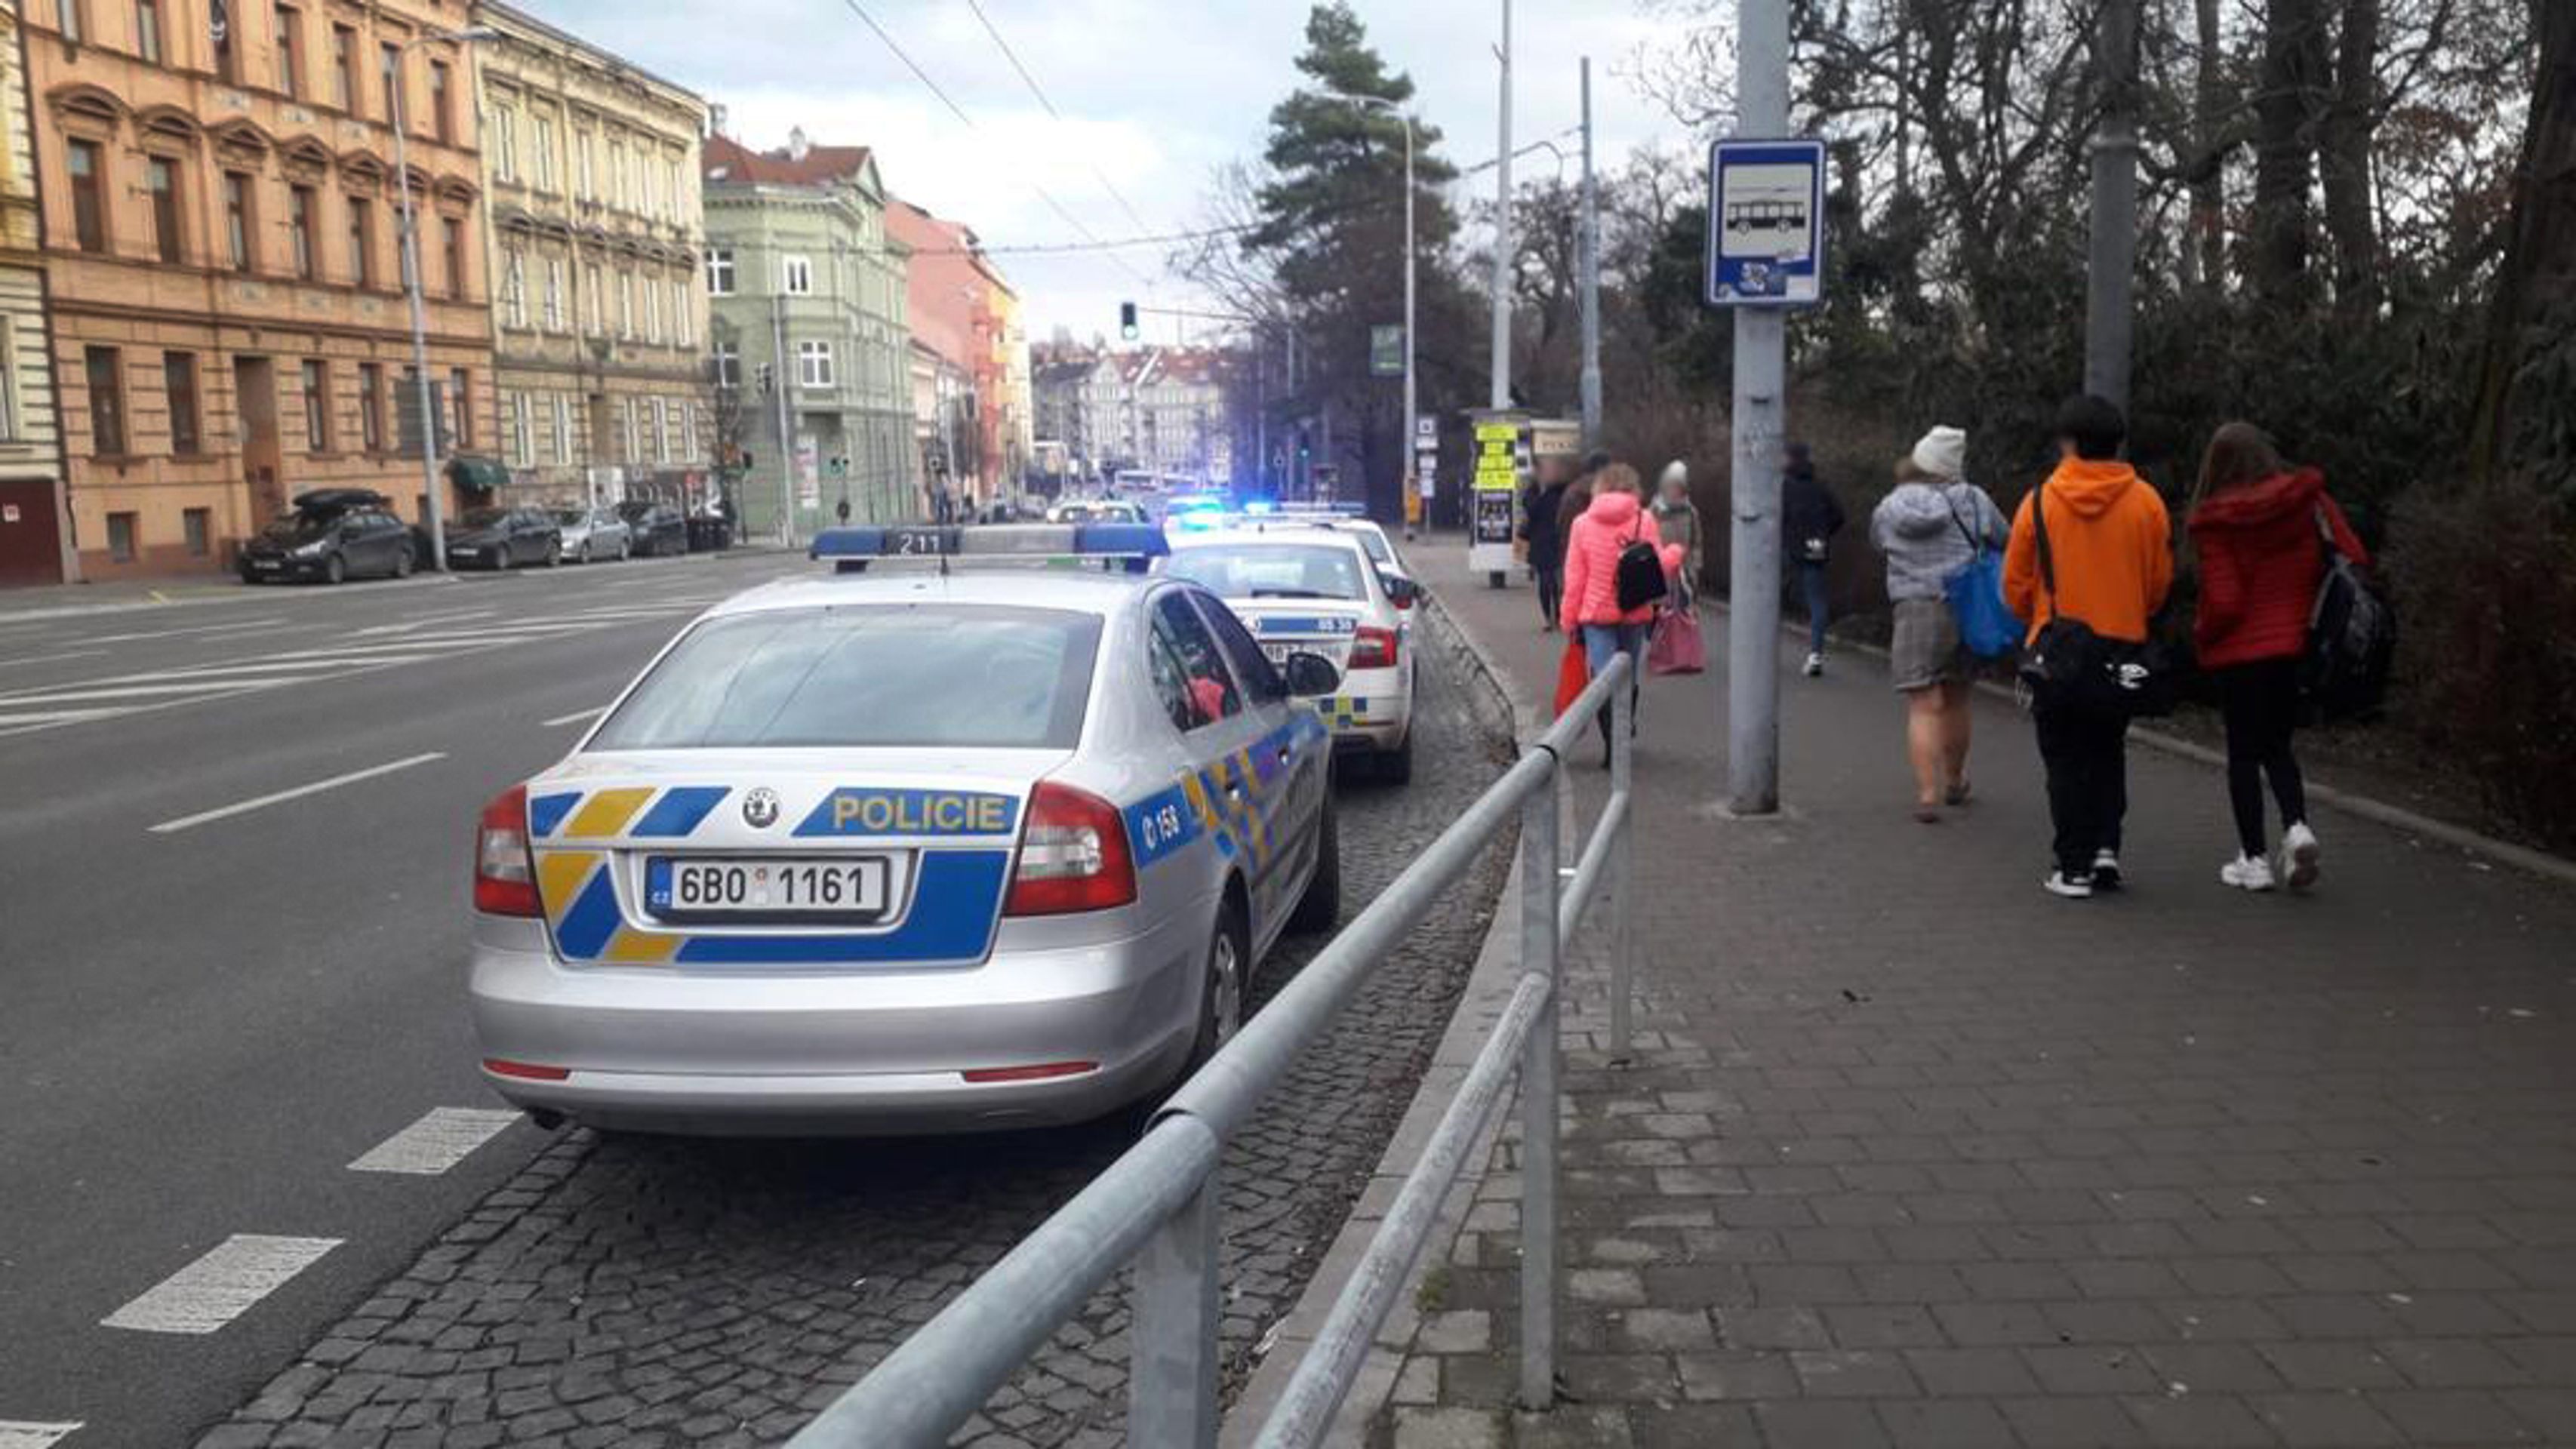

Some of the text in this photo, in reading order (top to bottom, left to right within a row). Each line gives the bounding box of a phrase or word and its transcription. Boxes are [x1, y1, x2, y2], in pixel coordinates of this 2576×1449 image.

[900, 534, 940, 555] 211
[833, 795, 1008, 830] POLICIE
[681, 867, 863, 903] 6B0 1161
